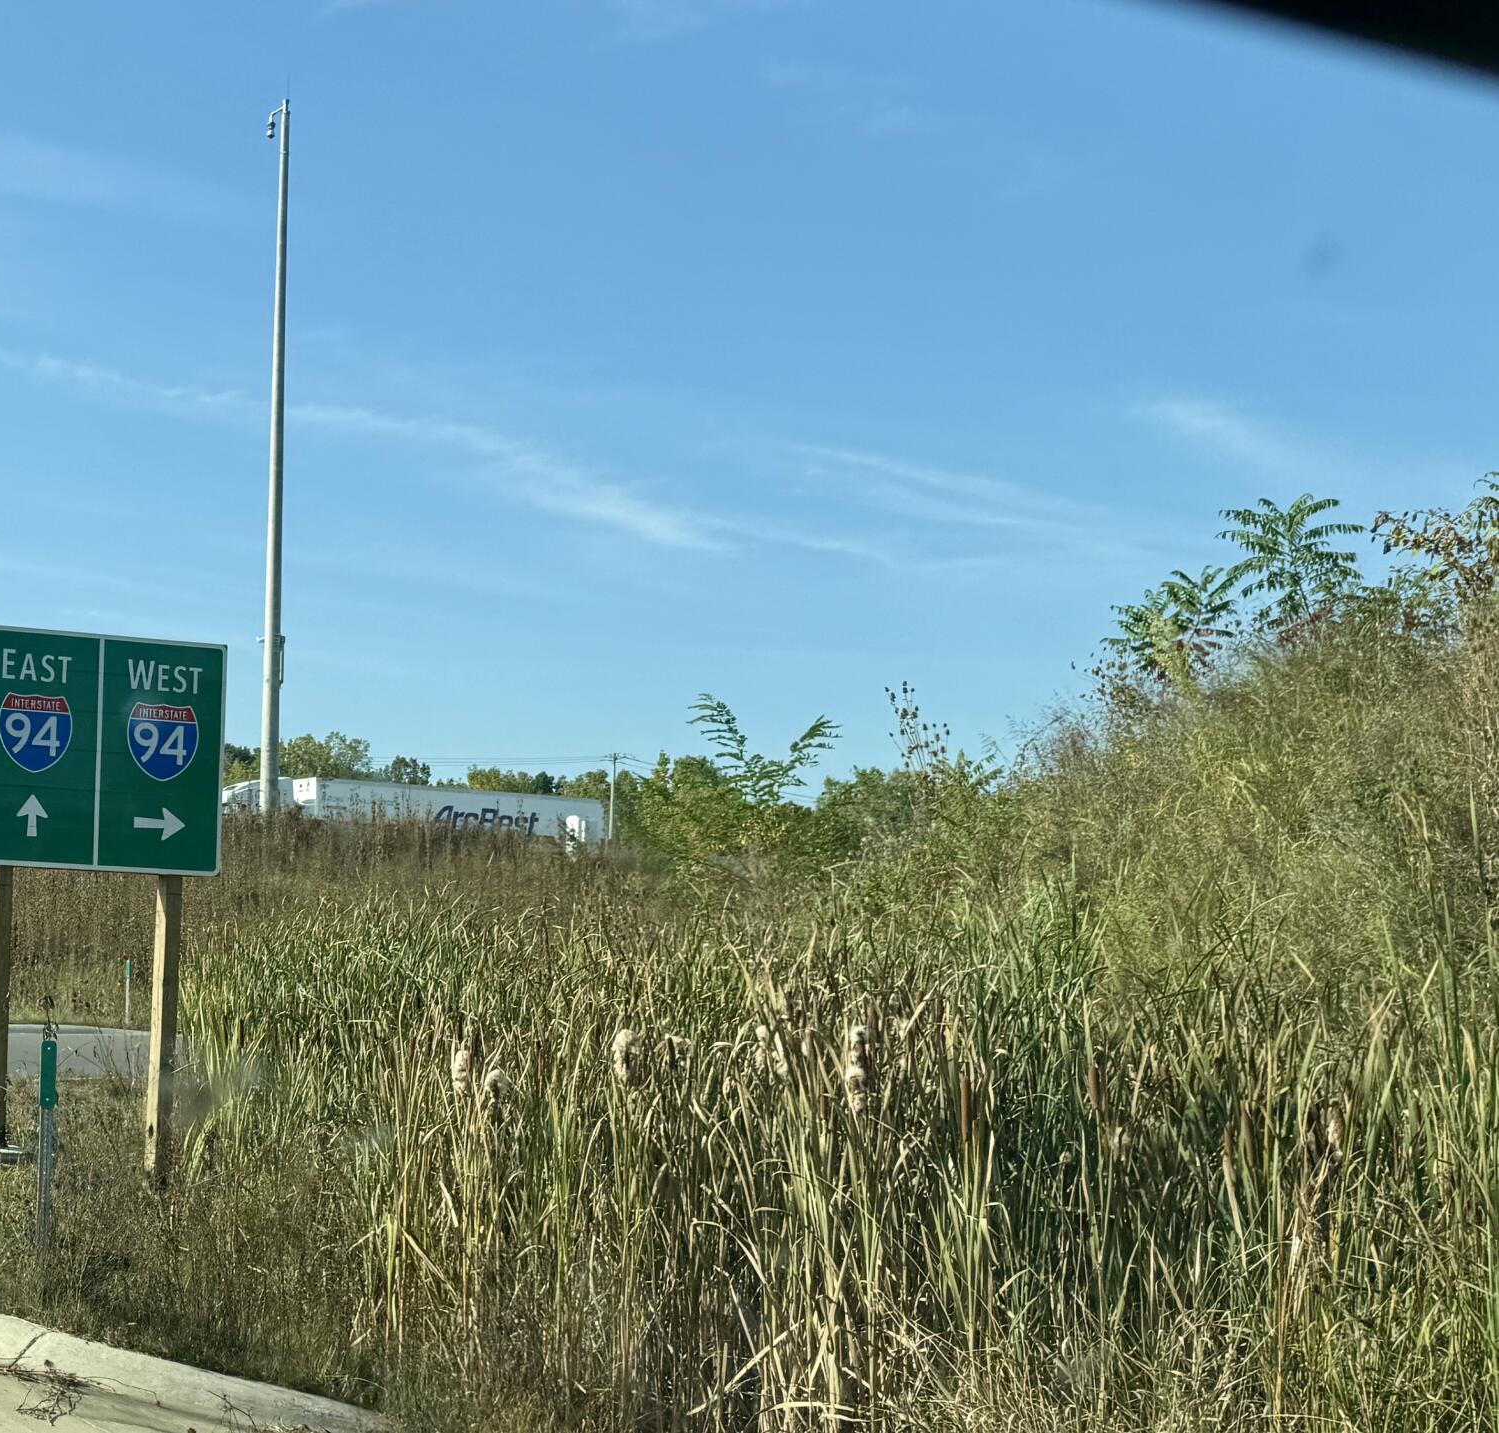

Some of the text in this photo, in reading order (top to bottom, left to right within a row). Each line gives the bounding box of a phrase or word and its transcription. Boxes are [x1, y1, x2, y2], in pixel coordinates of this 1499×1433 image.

[2, 648, 72, 684] EAST
[128, 658, 203, 695] WEST
[11, 697, 61, 711] INTERSTATE
[140, 707, 188, 721] INTERSTATE
[5, 712, 60, 757] 94
[133, 721, 187, 766] 94
